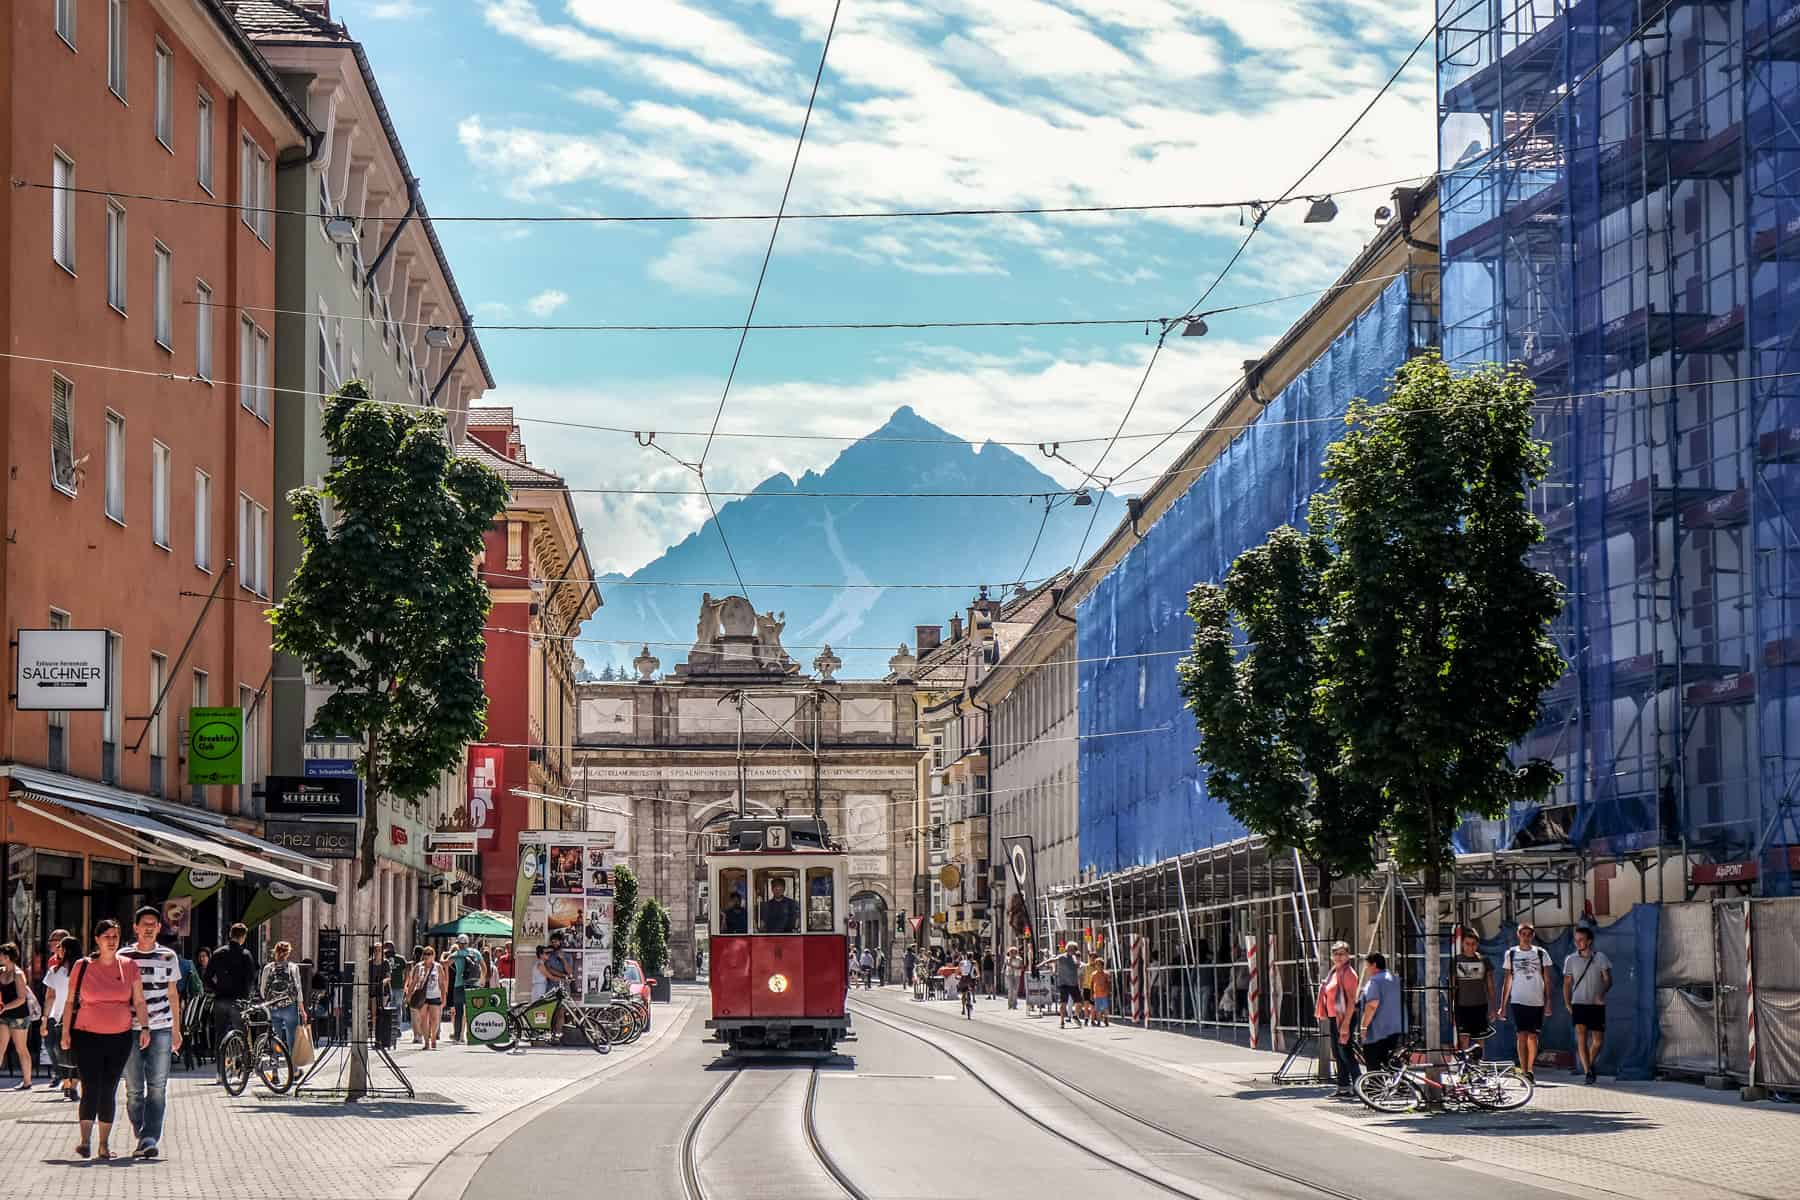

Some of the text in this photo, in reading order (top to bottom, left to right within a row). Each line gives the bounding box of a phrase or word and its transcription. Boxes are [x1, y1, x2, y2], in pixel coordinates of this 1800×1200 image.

[22, 667, 101, 680] SALCHNER
[198, 734, 235, 742] Breakfast
[198, 743, 215, 751] Club
[272, 831, 347, 848] chez nico
[474, 1020, 504, 1028] Breakfast
